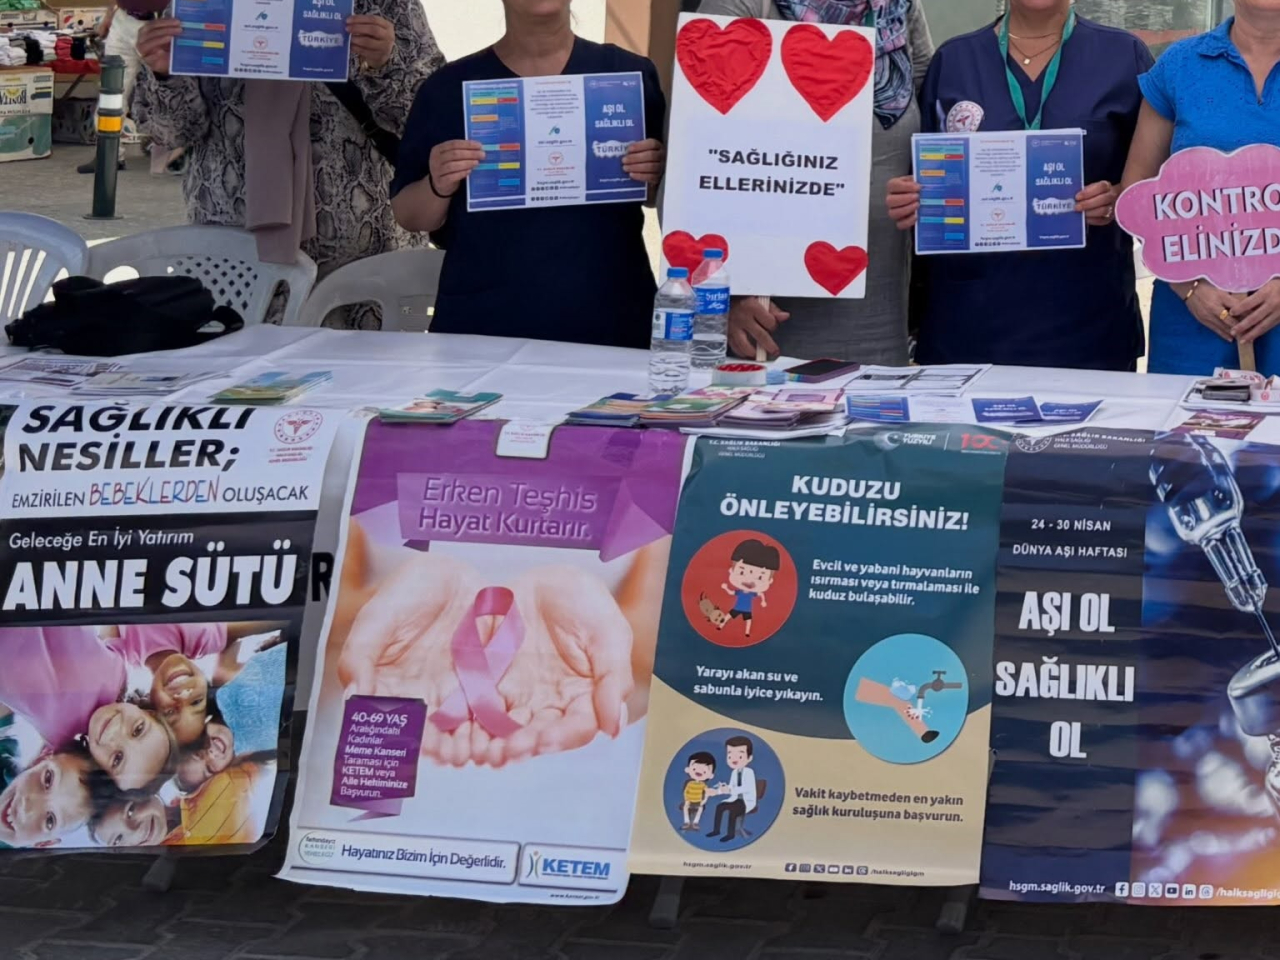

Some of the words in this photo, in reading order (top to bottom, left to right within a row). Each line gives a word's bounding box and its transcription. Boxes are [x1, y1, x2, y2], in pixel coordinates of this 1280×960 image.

[708, 148, 838, 170] "SAĞLIĞINIZ
[699, 175, 845, 196] ELLERİNİZDE"
[21, 405, 257, 435] SAĞLIKLI
[19, 431, 241, 473] NESİLLER;
[11, 487, 86, 510] EMZİRİLEN
[89, 475, 220, 506] BEBEKLERDEN
[222, 485, 309, 506] OLUŞACAK
[423, 477, 501, 504] Erken
[510, 482, 596, 513] Teşhis
[791, 474, 901, 500] KUDUZU
[419, 506, 491, 534] Hayat
[497, 512, 592, 540] Kurtarır.
[719, 493, 969, 531] ÖNLEYEBİLİRSİNİZ!
[1031, 519, 1045, 530] 24
[1055, 519, 1069, 531] 30
[1074, 514, 1111, 532] NİSAN
[9, 530, 83, 551] Geleceğe
[88, 529, 108, 546] En
[113, 526, 133, 550] İyi
[138, 528, 194, 545] Yatırım
[1013, 542, 1051, 556] DÜNYA
[1054, 545, 1075, 558] AŞI
[1078, 545, 1127, 558] HAFTASI
[2, 559, 147, 612] ANNE
[161, 539, 297, 608] SÜTÜ
[813, 559, 842, 572] Evcil
[844, 563, 858, 573] ve
[859, 561, 901, 578] yabani
[902, 564, 973, 581] hayvanların
[810, 574, 858, 588] ısırması
[860, 579, 889, 591] veya
[890, 579, 962, 593] tırmalaması
[964, 581, 979, 595] ile
[809, 588, 846, 602] kuduz
[848, 589, 915, 607] bulaşabilir.
[1019, 591, 1070, 636] AŞI
[1079, 593, 1115, 633] OL
[695, 666, 733, 682] Yarayı
[735, 669, 764, 681] akan
[766, 672, 781, 682] su
[784, 673, 798, 683] ve
[995, 656, 1135, 702] SAĞLIKLI
[693, 681, 741, 697] sabunla
[743, 685, 772, 701] iyice
[774, 687, 823, 703] yıkayın.
[351, 711, 384, 724] 40-69
[385, 713, 408, 727] YAŞ
[345, 744, 372, 755] Meme
[374, 746, 407, 758] Kanseri
[1049, 721, 1086, 759] OL
[344, 755, 382, 767] Taraması
[342, 766, 374, 776] KETEM
[375, 769, 396, 779] veya
[795, 787, 824, 800] Vakit
[827, 788, 910, 806] kaybetmeden
[913, 794, 928, 804] en
[930, 793, 964, 808] yakın
[792, 803, 829, 821] sağlık
[831, 806, 901, 822] kuruluşuna
[903, 808, 964, 824] başvurun.
[341, 844, 395, 861] Hayatınız
[396, 848, 427, 863] Bizim
[429, 847, 448, 867] İçin
[450, 852, 506, 869] Değerlidir.
[542, 858, 611, 876] KETEM
[1009, 881, 1105, 895] hsgm.saglik.gov.tr
